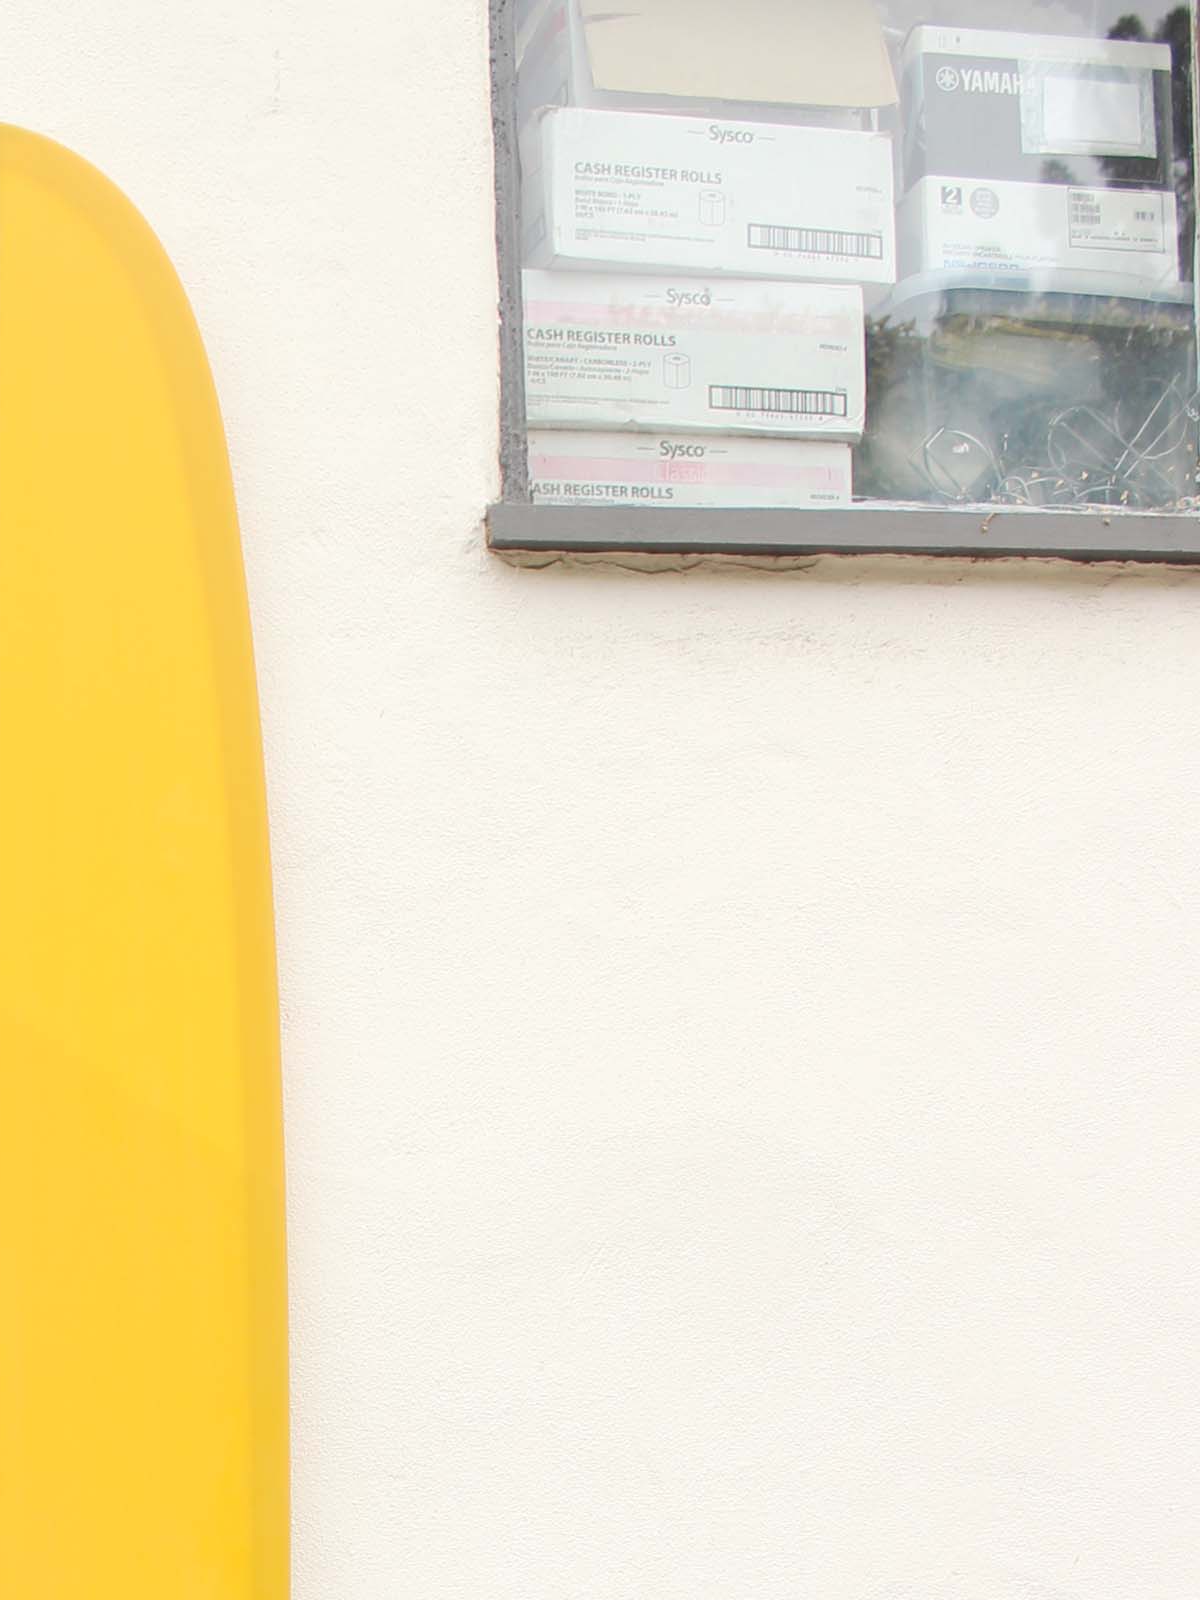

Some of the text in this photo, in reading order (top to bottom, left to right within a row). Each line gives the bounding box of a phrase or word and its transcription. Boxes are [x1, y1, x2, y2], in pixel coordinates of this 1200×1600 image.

[960, 68, 1035, 95] YAMAH
[709, 125, 754, 144] Sysco
[574, 162, 611, 176] CASH
[614, 164, 678, 182] REGISTER
[681, 170, 722, 185] ROLLS
[945, 186, 958, 203] 2
[666, 288, 711, 307] Sysco
[527, 328, 676, 347] CASH REGISTER ROLLS
[659, 440, 704, 458] Sysco
[533, 482, 560, 496] ASH
[564, 483, 628, 498] REGISTER
[631, 486, 673, 500] ROLLS
